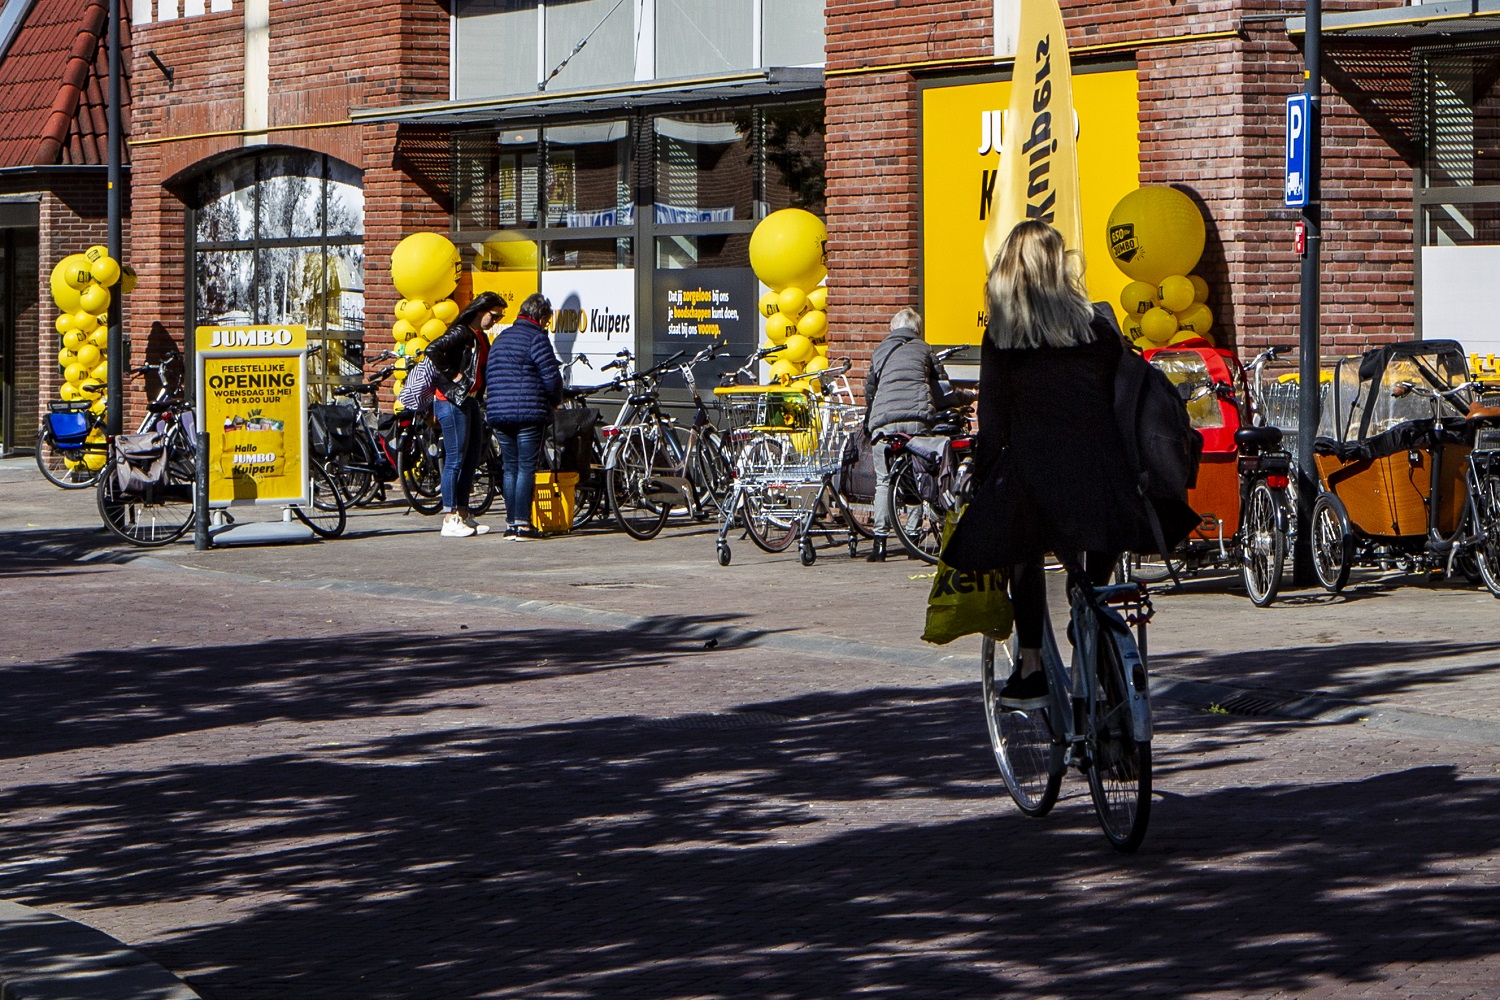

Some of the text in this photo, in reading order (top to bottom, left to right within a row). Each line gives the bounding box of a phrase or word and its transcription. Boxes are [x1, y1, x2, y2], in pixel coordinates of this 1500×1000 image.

[1290, 105, 1302, 158] P
[668, 290, 677, 302] Dat
[683, 287, 711, 306] zorgeloos
[712, 289, 720, 305] bij
[720, 292, 729, 302] ons
[667, 305, 739, 322] je boodschappen kunt doen,
[550, 307, 631, 341] UMBO Kuipers
[668, 323, 681, 335] staat
[688, 325, 698, 335] ons
[698, 324, 721, 339] voorop.
[210, 329, 293, 348] JUMBO
[222, 364, 285, 373] FEESTELIJKE
[209, 373, 295, 389] OPENING
[214, 389, 265, 397] WOENSDAG
[234, 444, 257, 453] Hallo
[233, 452, 276, 464] JUMBO
[234, 464, 275, 477] Kuipers
